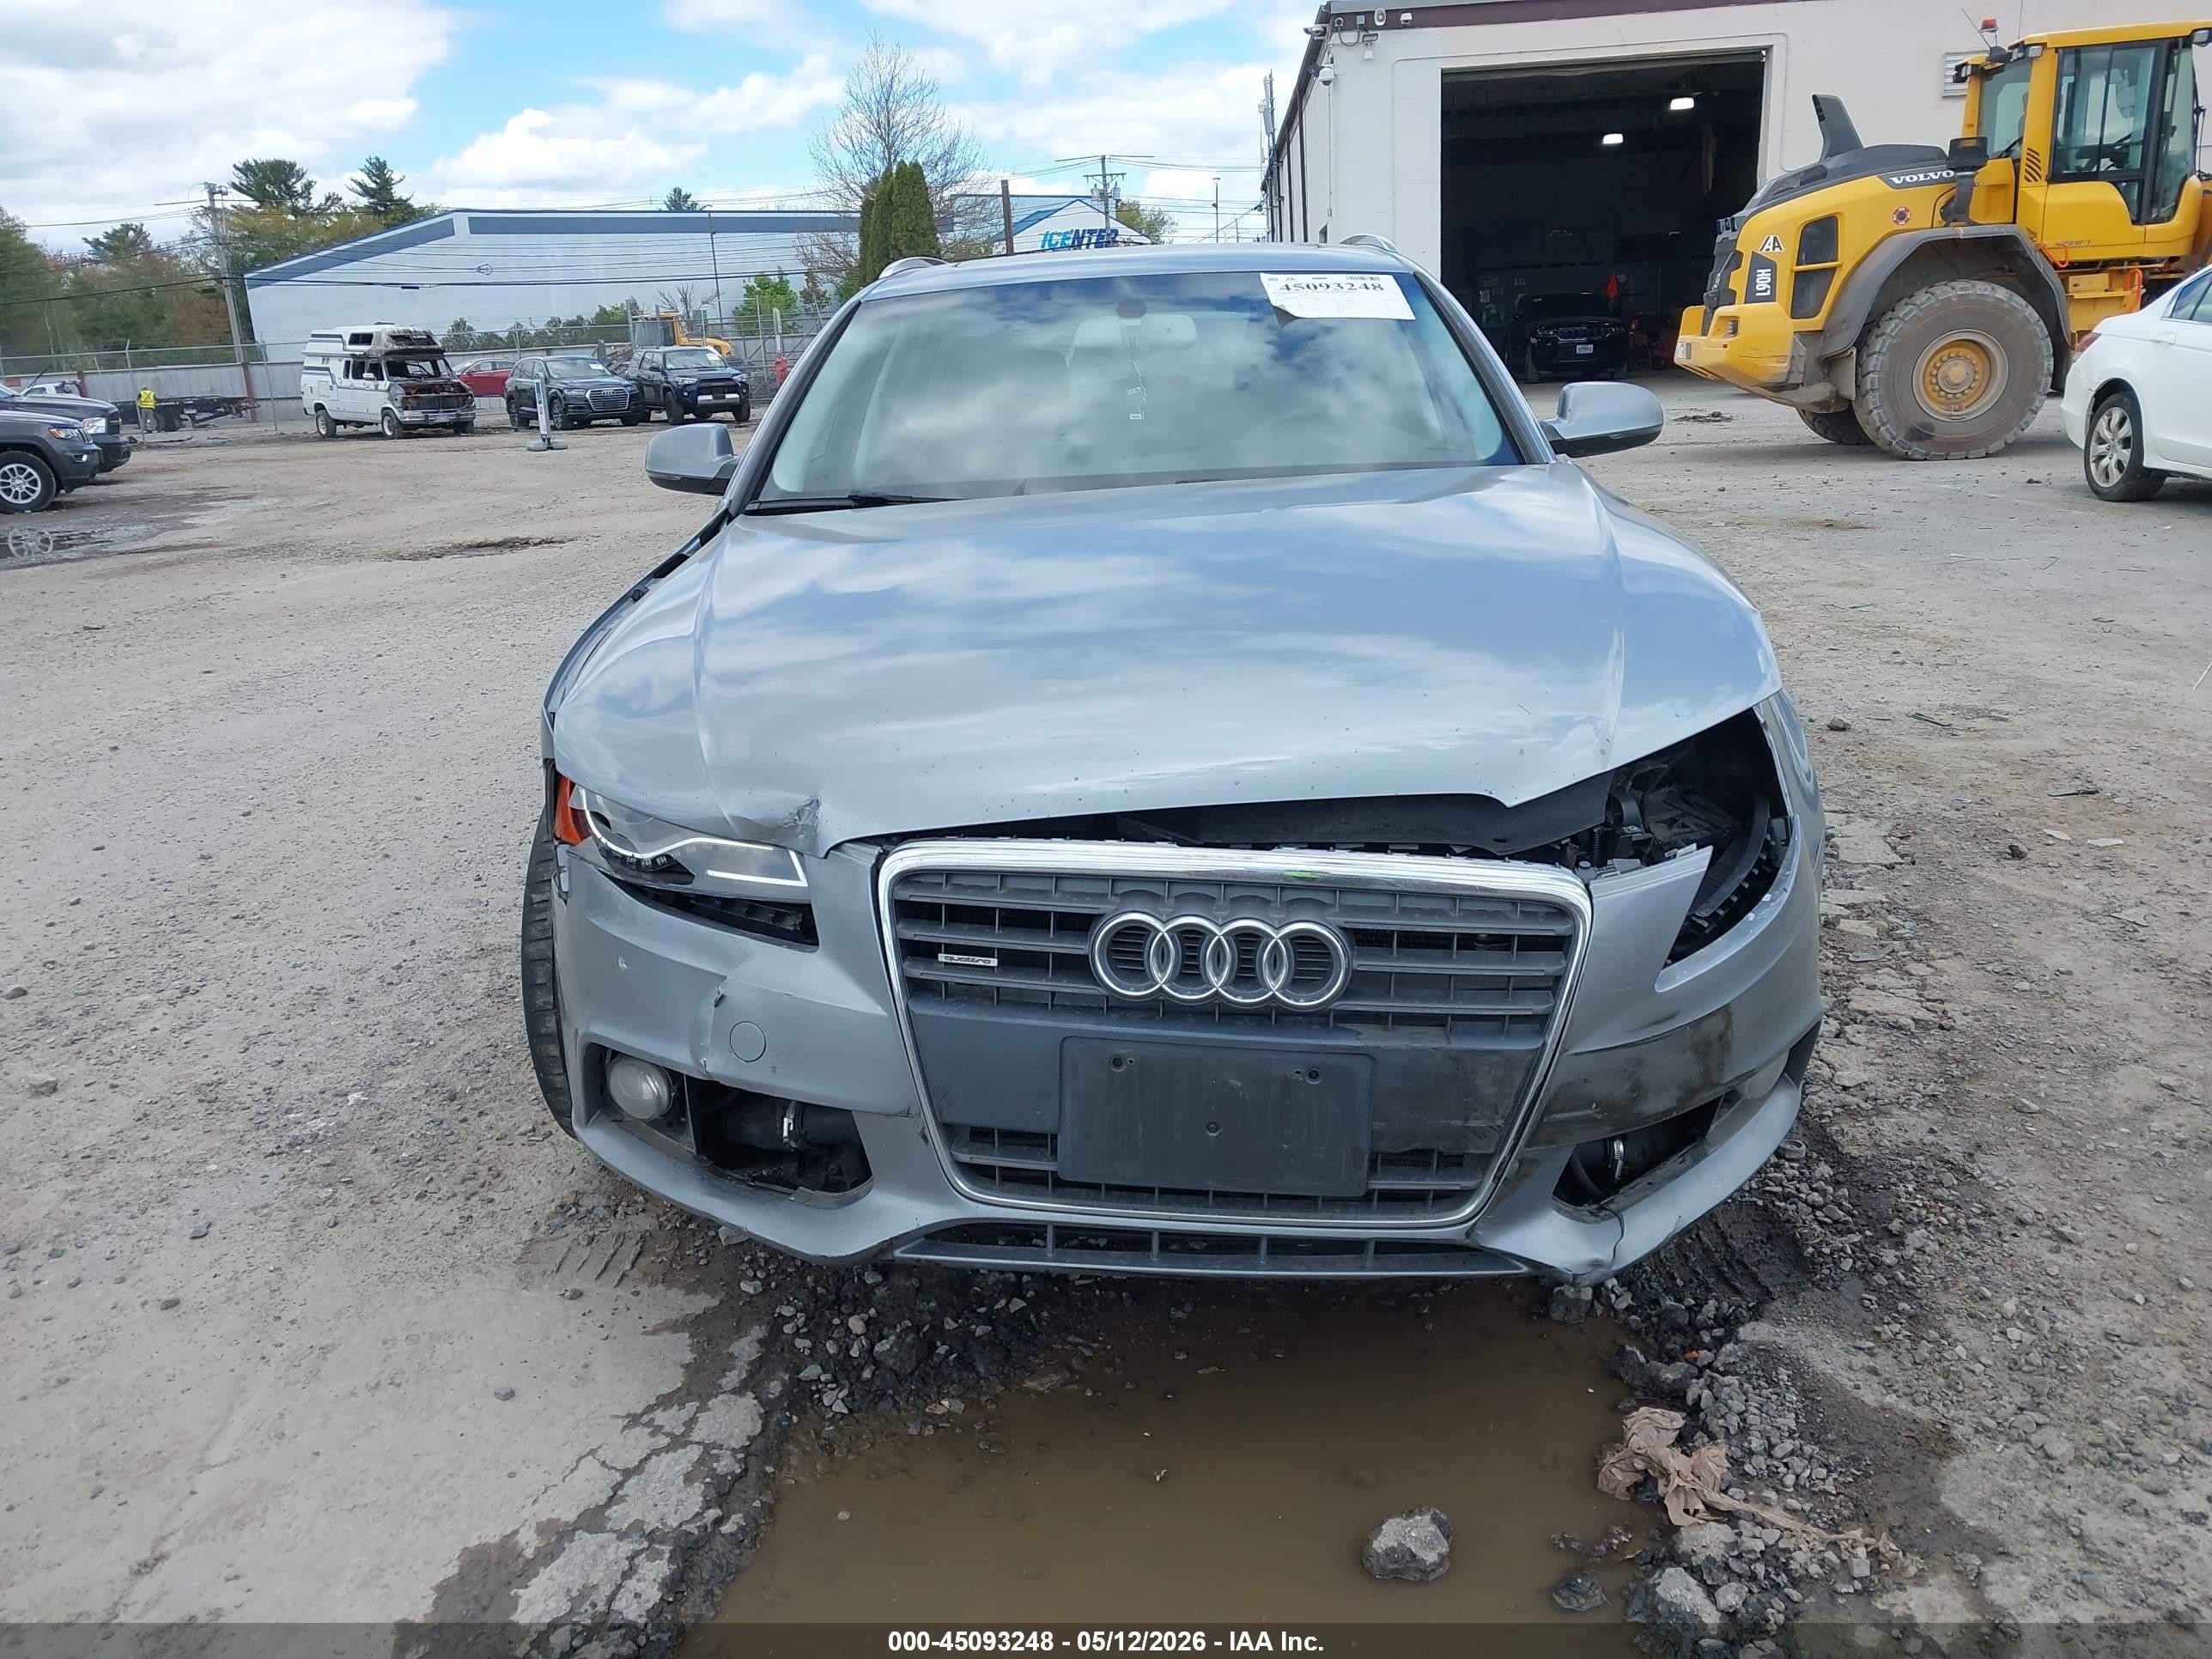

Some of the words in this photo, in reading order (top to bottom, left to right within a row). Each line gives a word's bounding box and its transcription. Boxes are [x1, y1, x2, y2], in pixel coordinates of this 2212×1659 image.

[1889, 170, 1955, 185] VOLVO
[1279, 282, 1385, 292] 45093248
[1755, 268, 1771, 296] L90H
[944, 955, 992, 964] quattro
